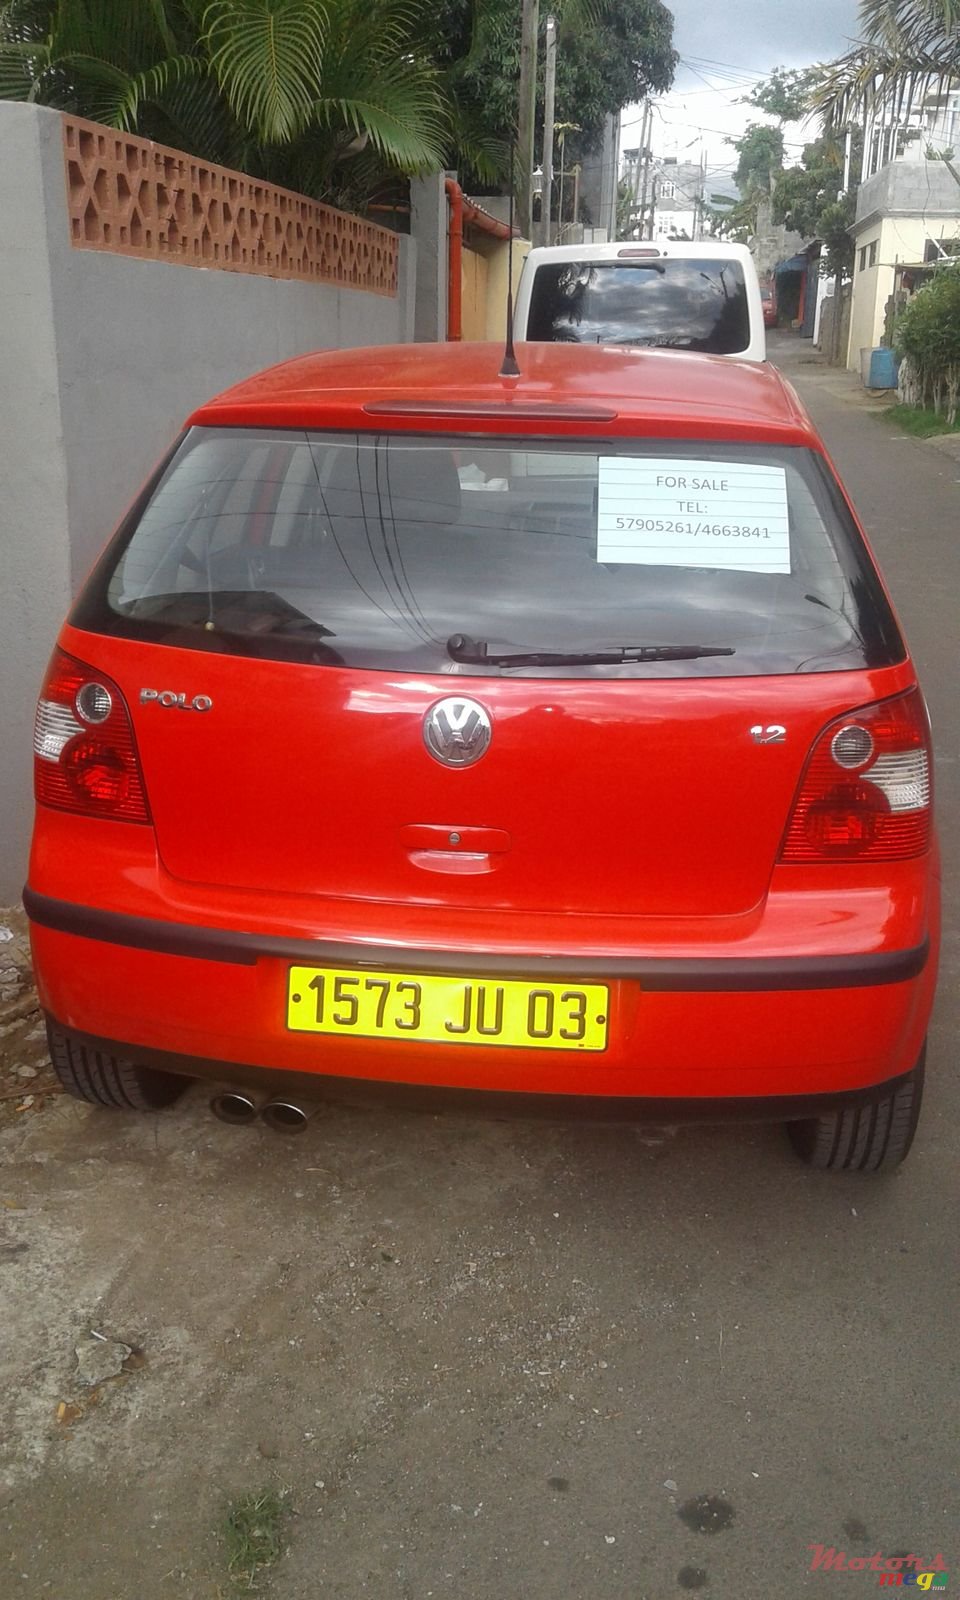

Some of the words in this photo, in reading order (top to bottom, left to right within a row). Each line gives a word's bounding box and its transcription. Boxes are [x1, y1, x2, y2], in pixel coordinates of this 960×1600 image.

[656, 476, 687, 489] FOR
[691, 479, 729, 491] SALE
[676, 501, 708, 513] TEL:
[616, 517, 771, 538] 57905261/4663841
[140, 687, 212, 712] POLO
[308, 975, 422, 1030] 1573
[444, 985, 504, 1035] JU
[527, 989, 587, 1040] 03
